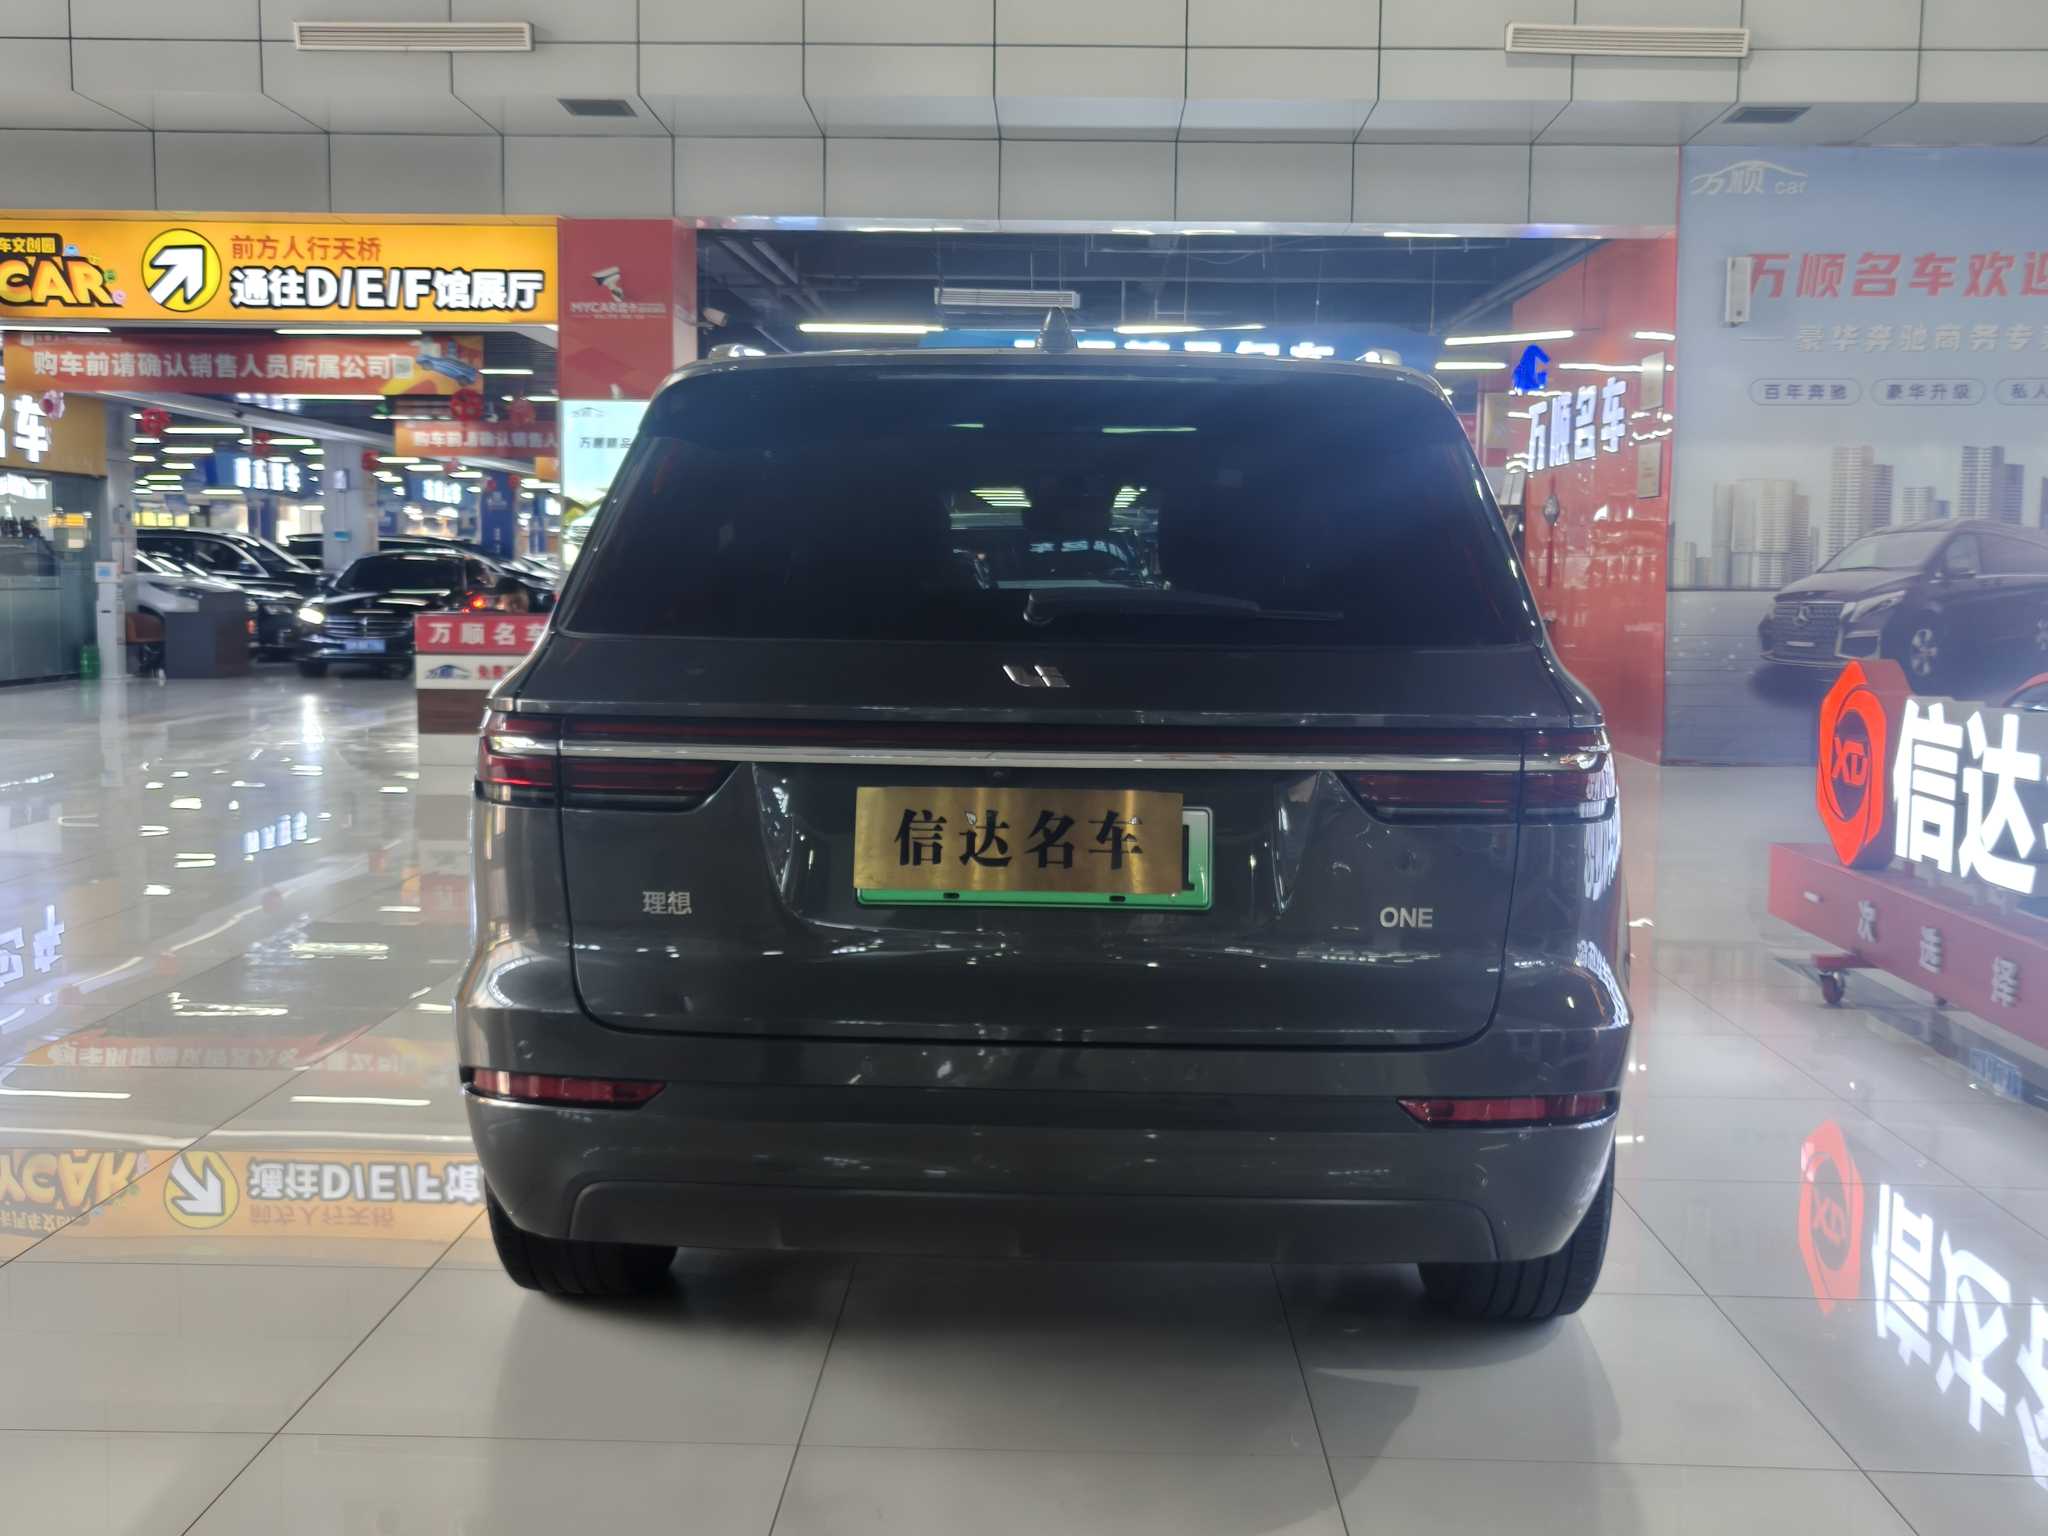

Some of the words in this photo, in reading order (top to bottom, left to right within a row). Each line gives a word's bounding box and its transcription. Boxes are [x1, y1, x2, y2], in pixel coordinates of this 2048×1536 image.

[231, 236, 382, 262] 前方人行天桥
[230, 267, 544, 310] 通往D/E/F馆展厅
[33, 351, 393, 379] 购车前请确认销售人员所属公司
[1526, 376, 1627, 473] 万顺名车
[894, 808, 1144, 870] 信达名车
[642, 891, 692, 914] 理想
[1380, 906, 1434, 928] ONE
